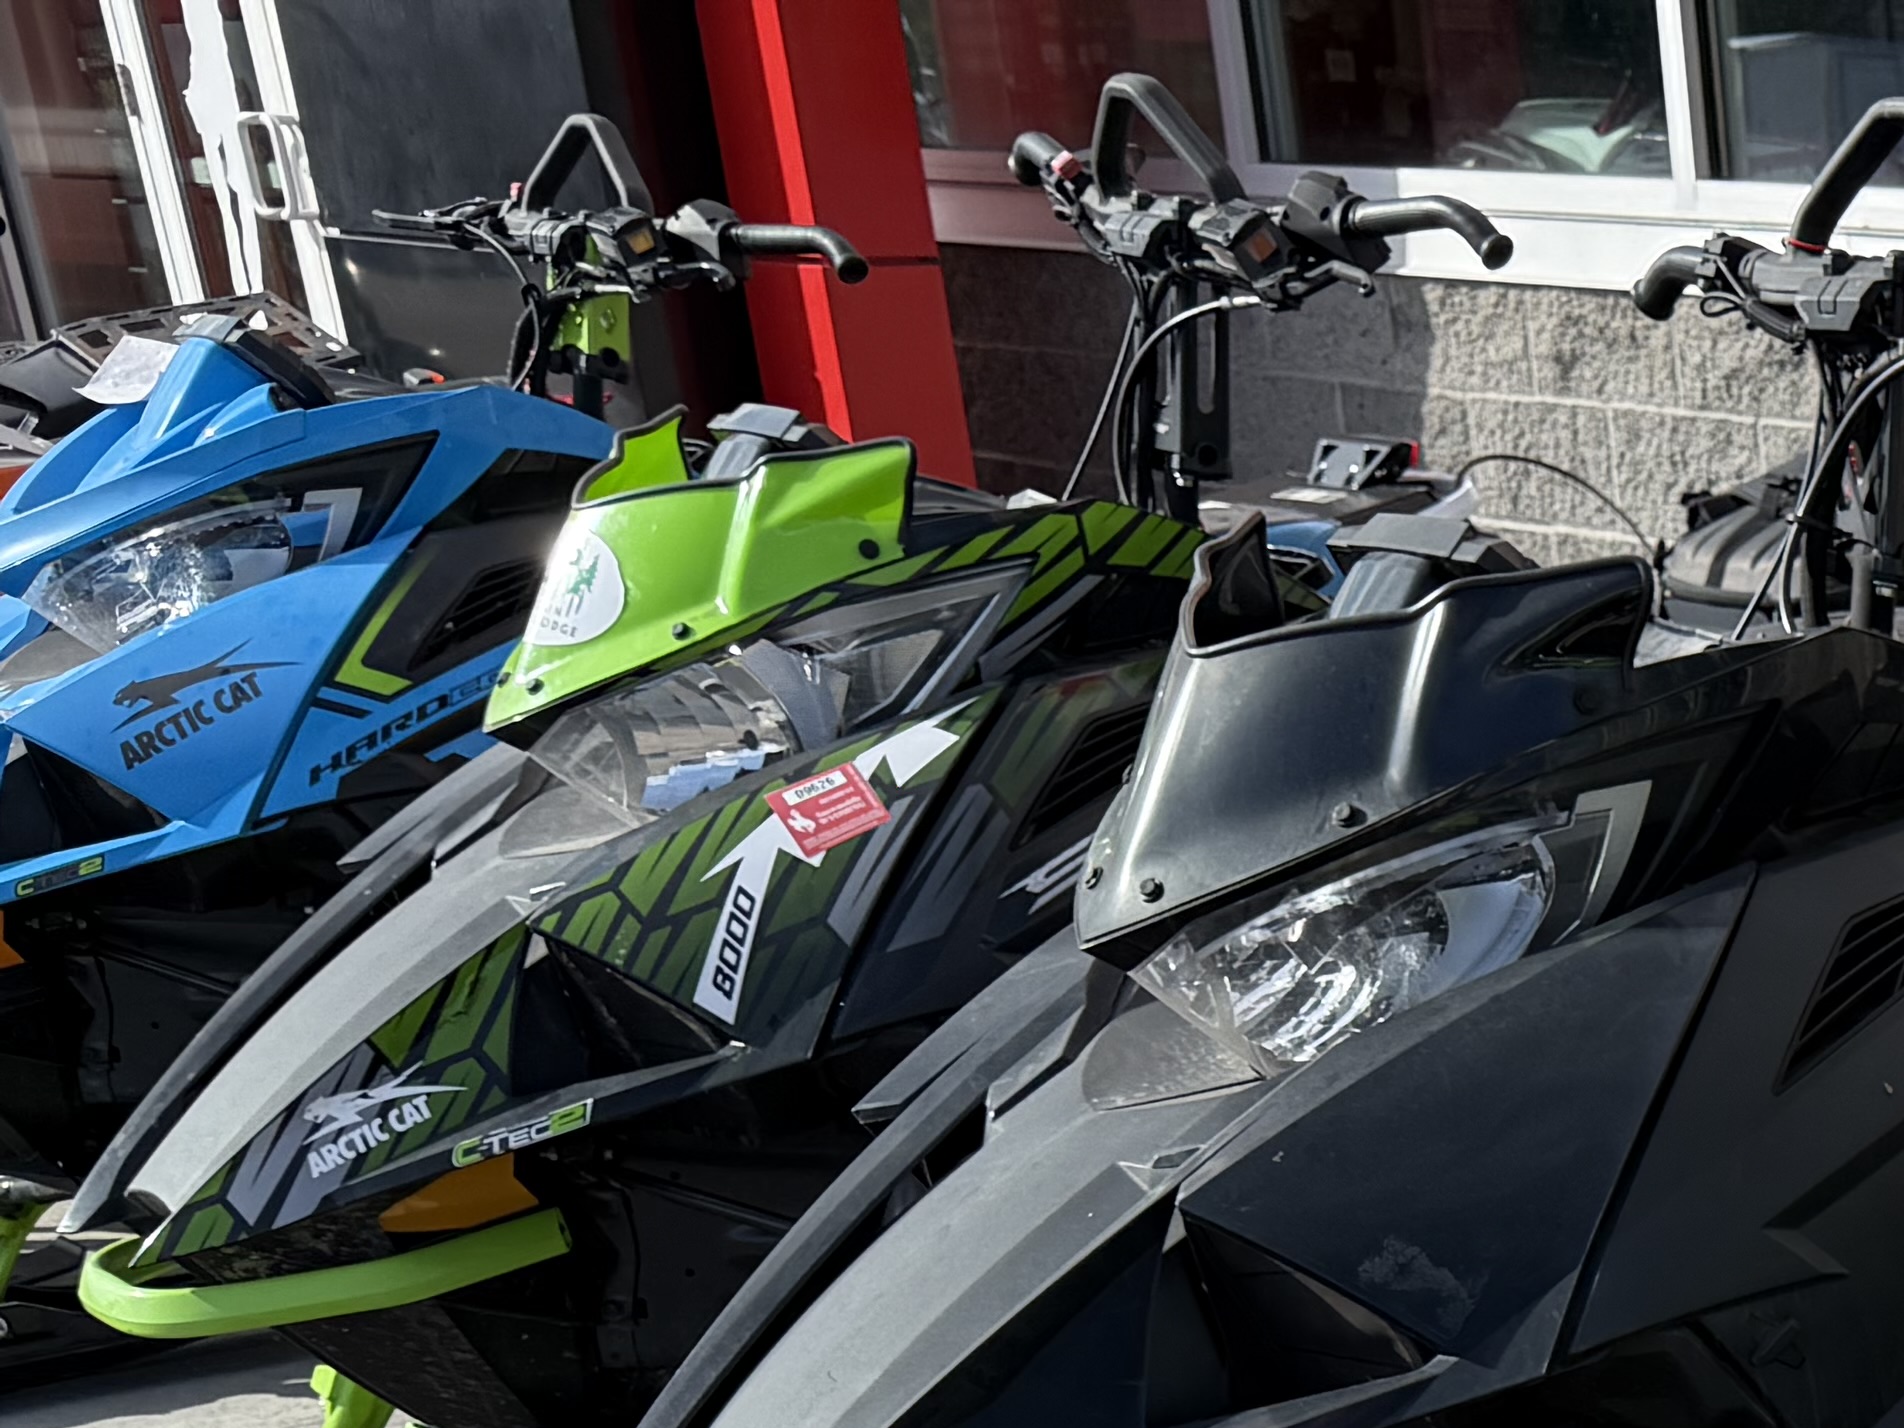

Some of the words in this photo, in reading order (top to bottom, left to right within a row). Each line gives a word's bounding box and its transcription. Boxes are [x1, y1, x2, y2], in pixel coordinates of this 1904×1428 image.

[535, 616, 578, 638] ODGE
[120, 699, 215, 771] ARCTIC
[213, 671, 263, 714] CAT
[712, 885, 756, 1001] 8000
[307, 1117, 390, 1179] ARCTIC
[388, 1095, 433, 1133] CAT
[455, 1102, 588, 1167] C-TEC2
